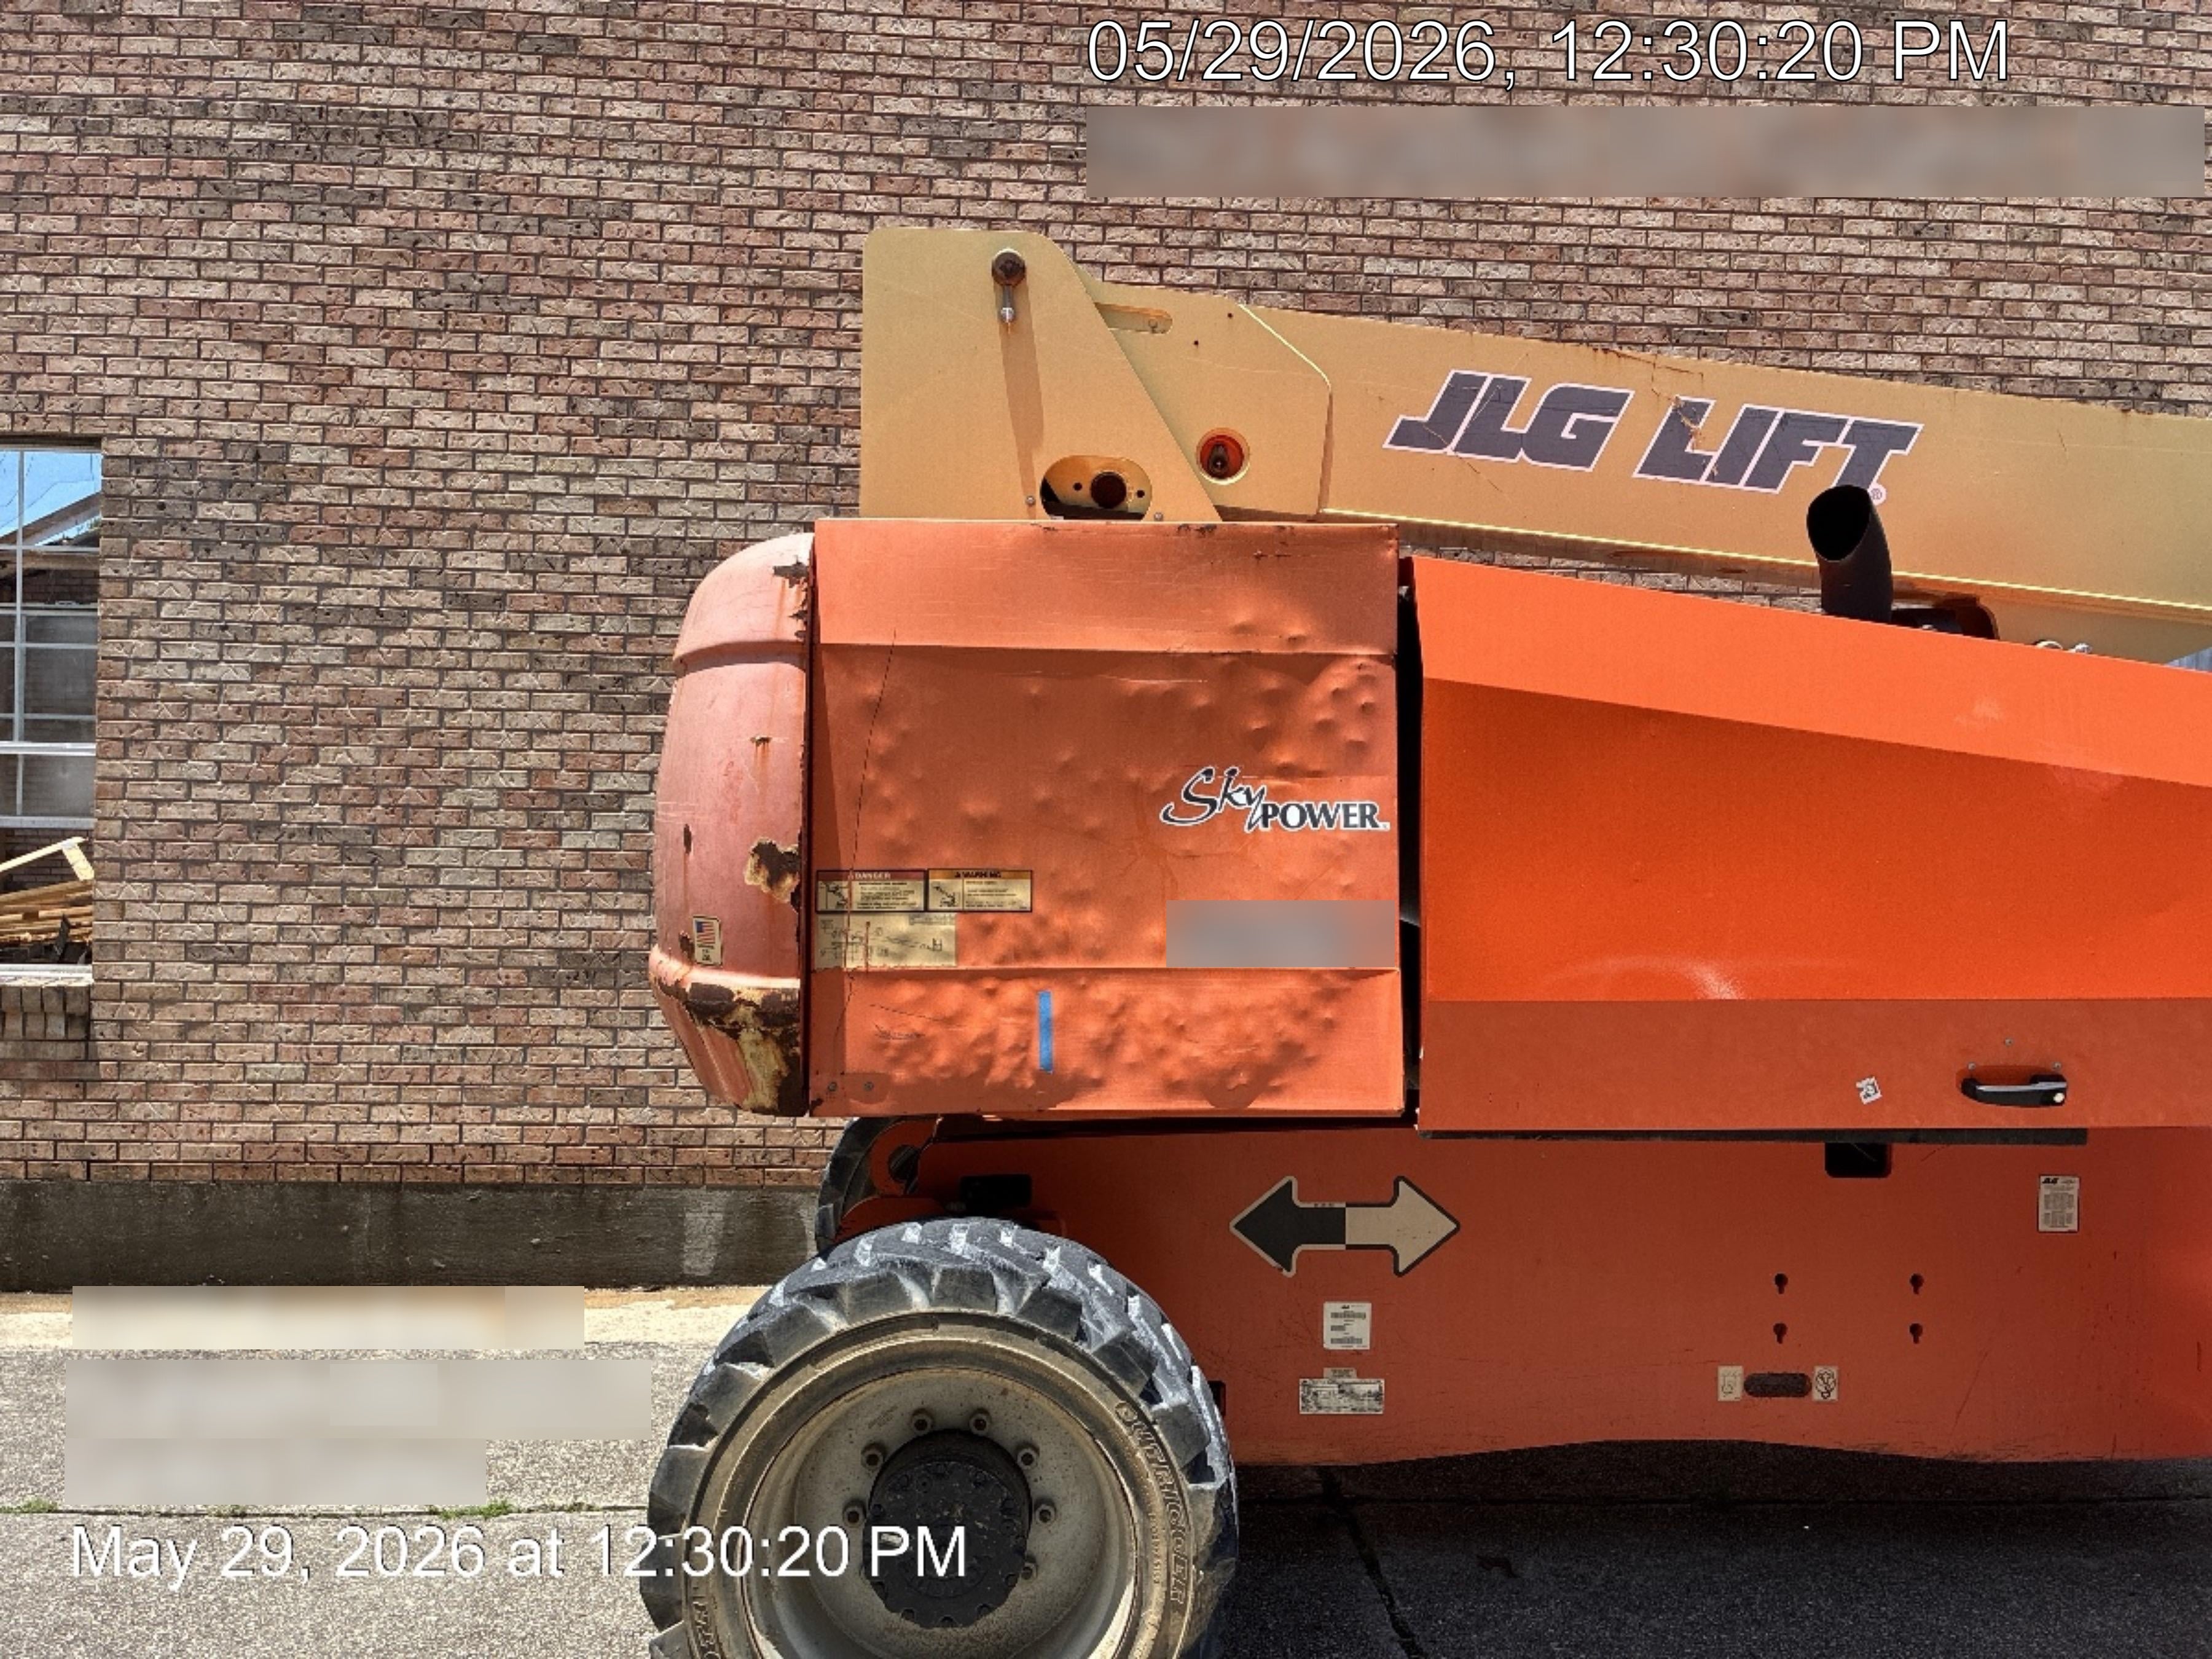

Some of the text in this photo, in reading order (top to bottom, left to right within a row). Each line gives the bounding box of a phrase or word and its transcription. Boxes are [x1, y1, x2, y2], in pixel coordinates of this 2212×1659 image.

[1382, 370, 1924, 493] JLG LIFT
[855, 871, 892, 880] DANGER
